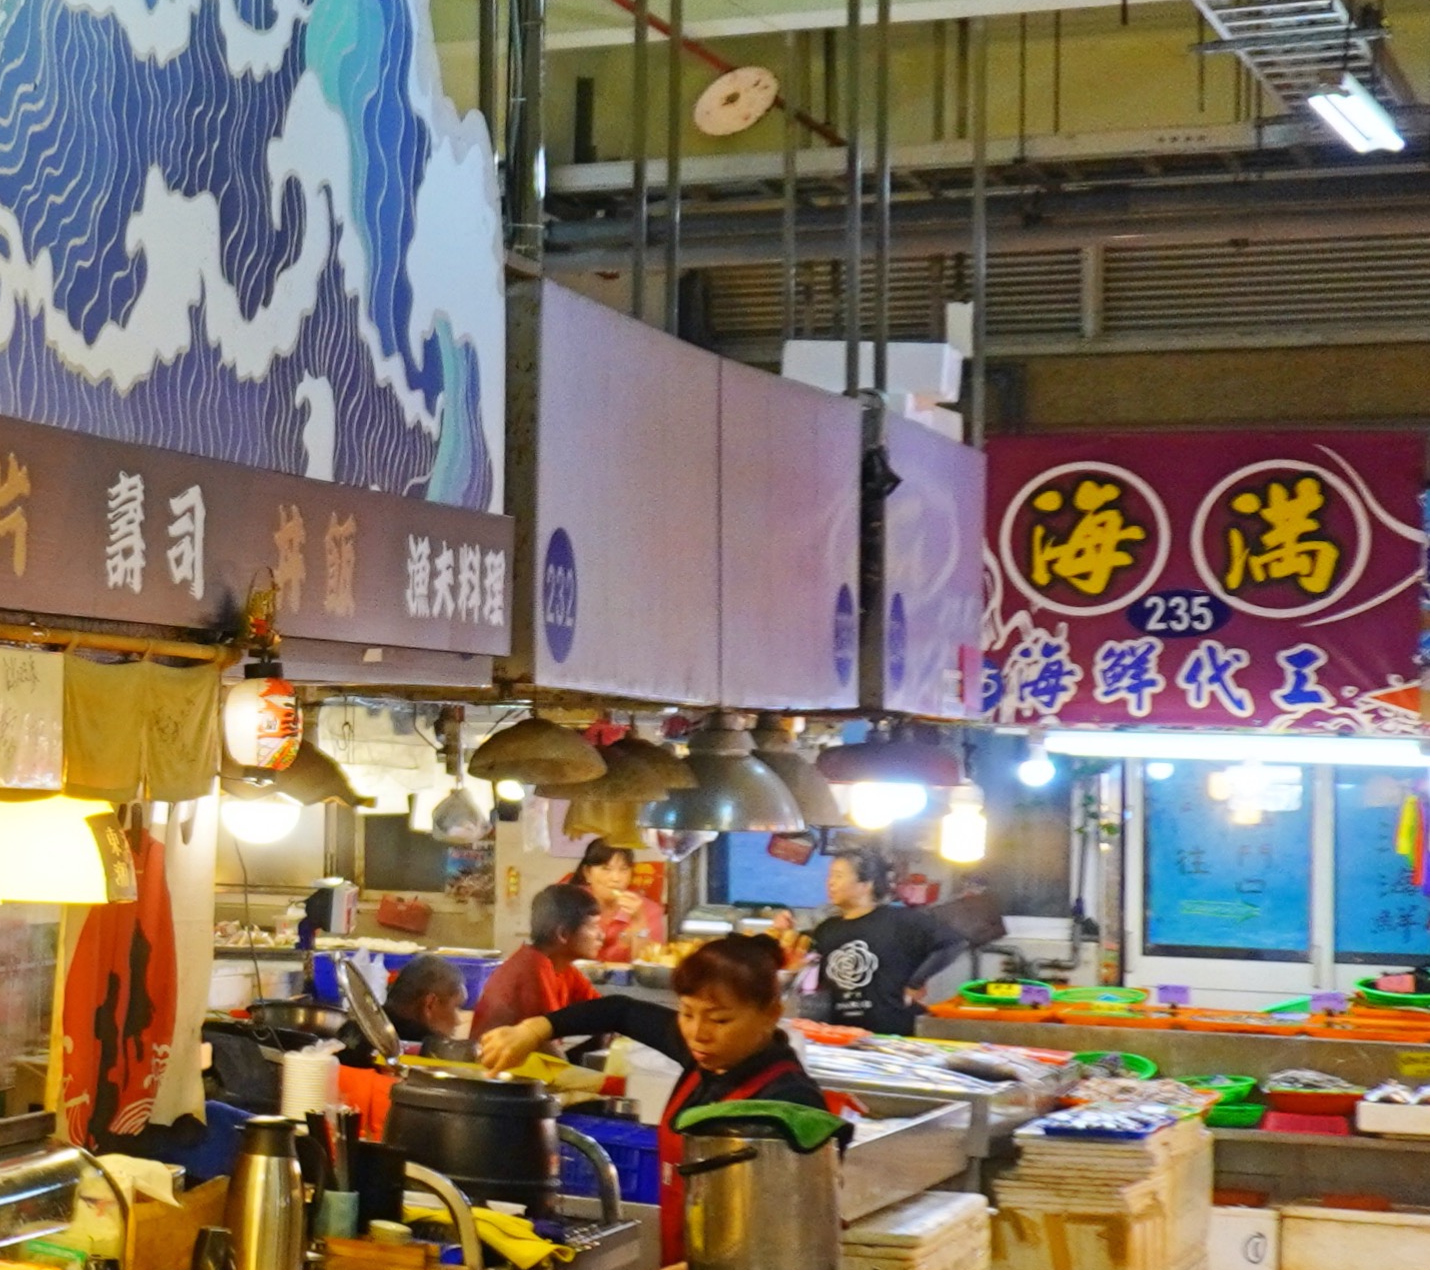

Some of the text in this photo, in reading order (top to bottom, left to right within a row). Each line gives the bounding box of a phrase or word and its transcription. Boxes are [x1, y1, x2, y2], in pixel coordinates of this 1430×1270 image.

[105, 470, 207, 601] 壽司
[405, 533, 506, 627] 漁夫料理
[1143, 595, 1214, 631] 235
